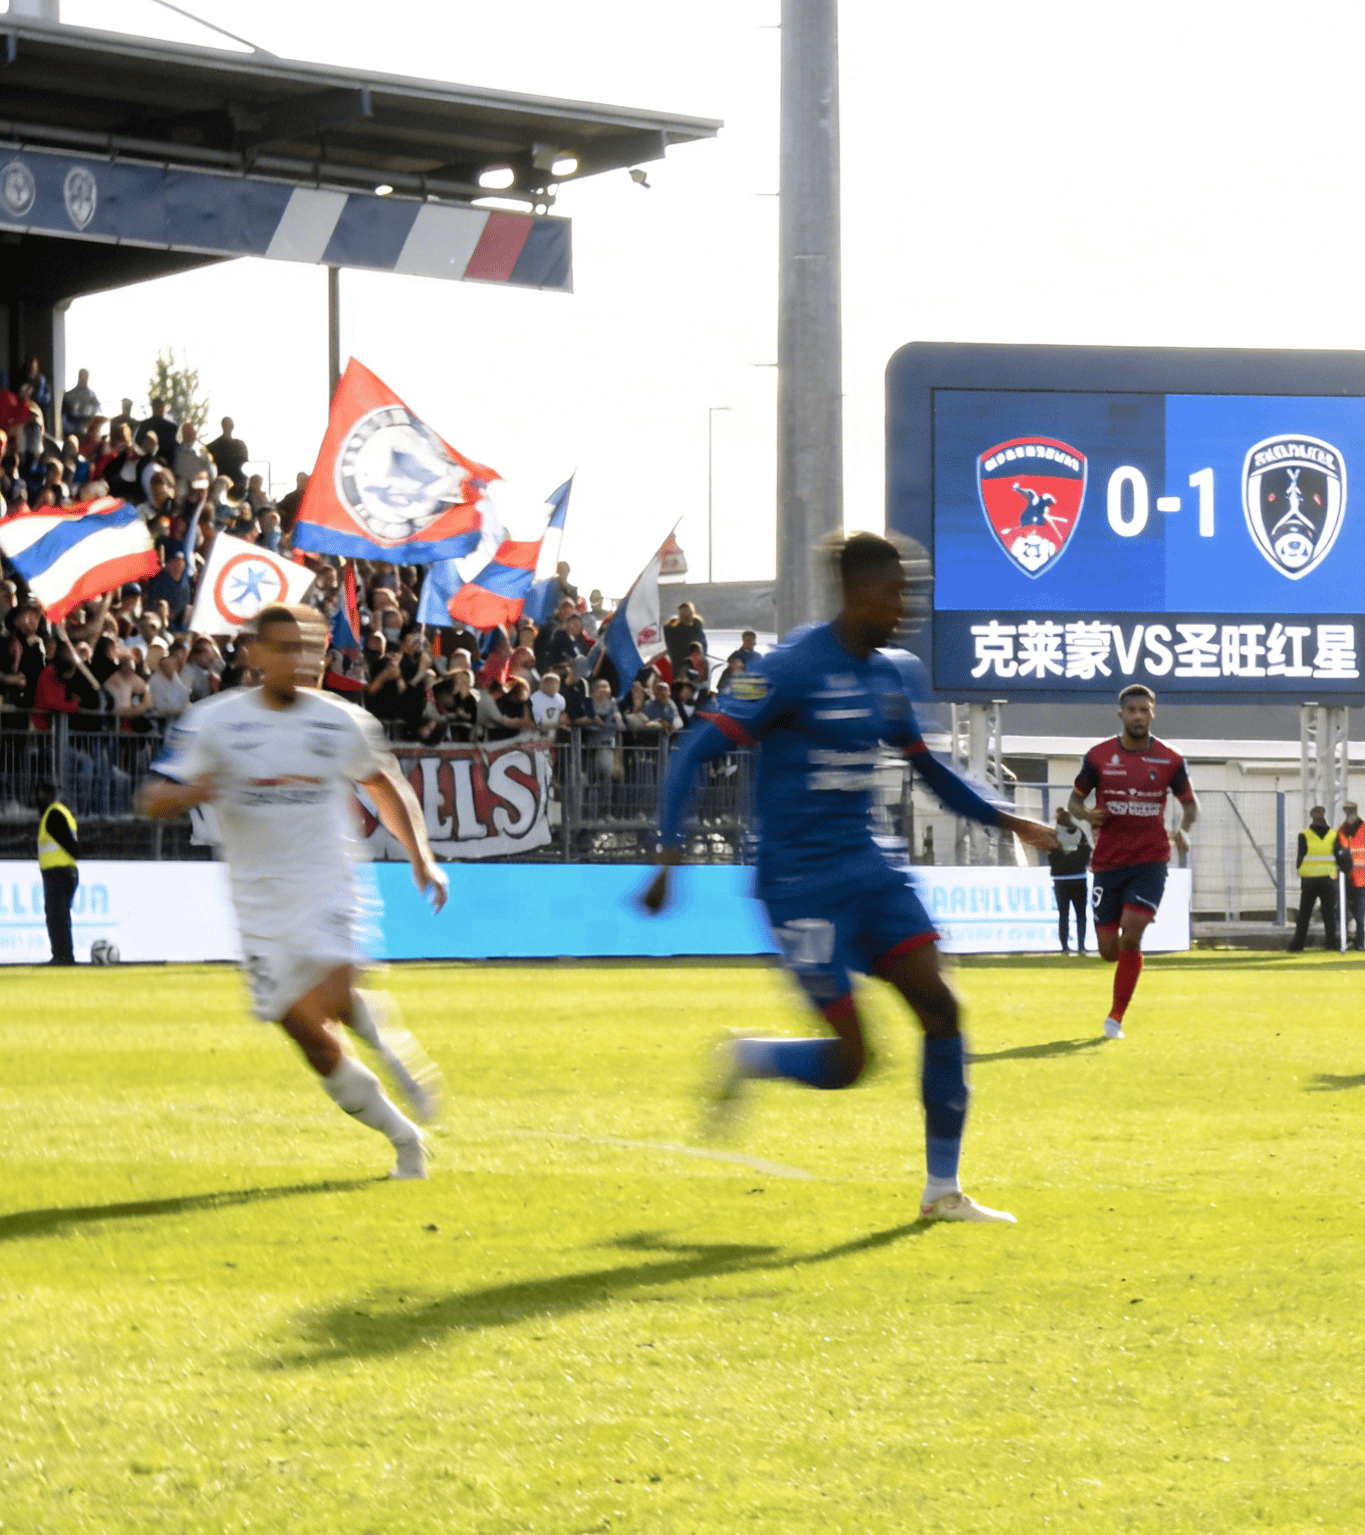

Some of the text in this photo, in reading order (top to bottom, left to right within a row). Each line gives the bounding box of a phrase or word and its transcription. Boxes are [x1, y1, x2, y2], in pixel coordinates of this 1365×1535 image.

[1106, 465, 1215, 537] 0-1
[970, 619, 1360, 679] 克莱蒙VS圣旺红星
